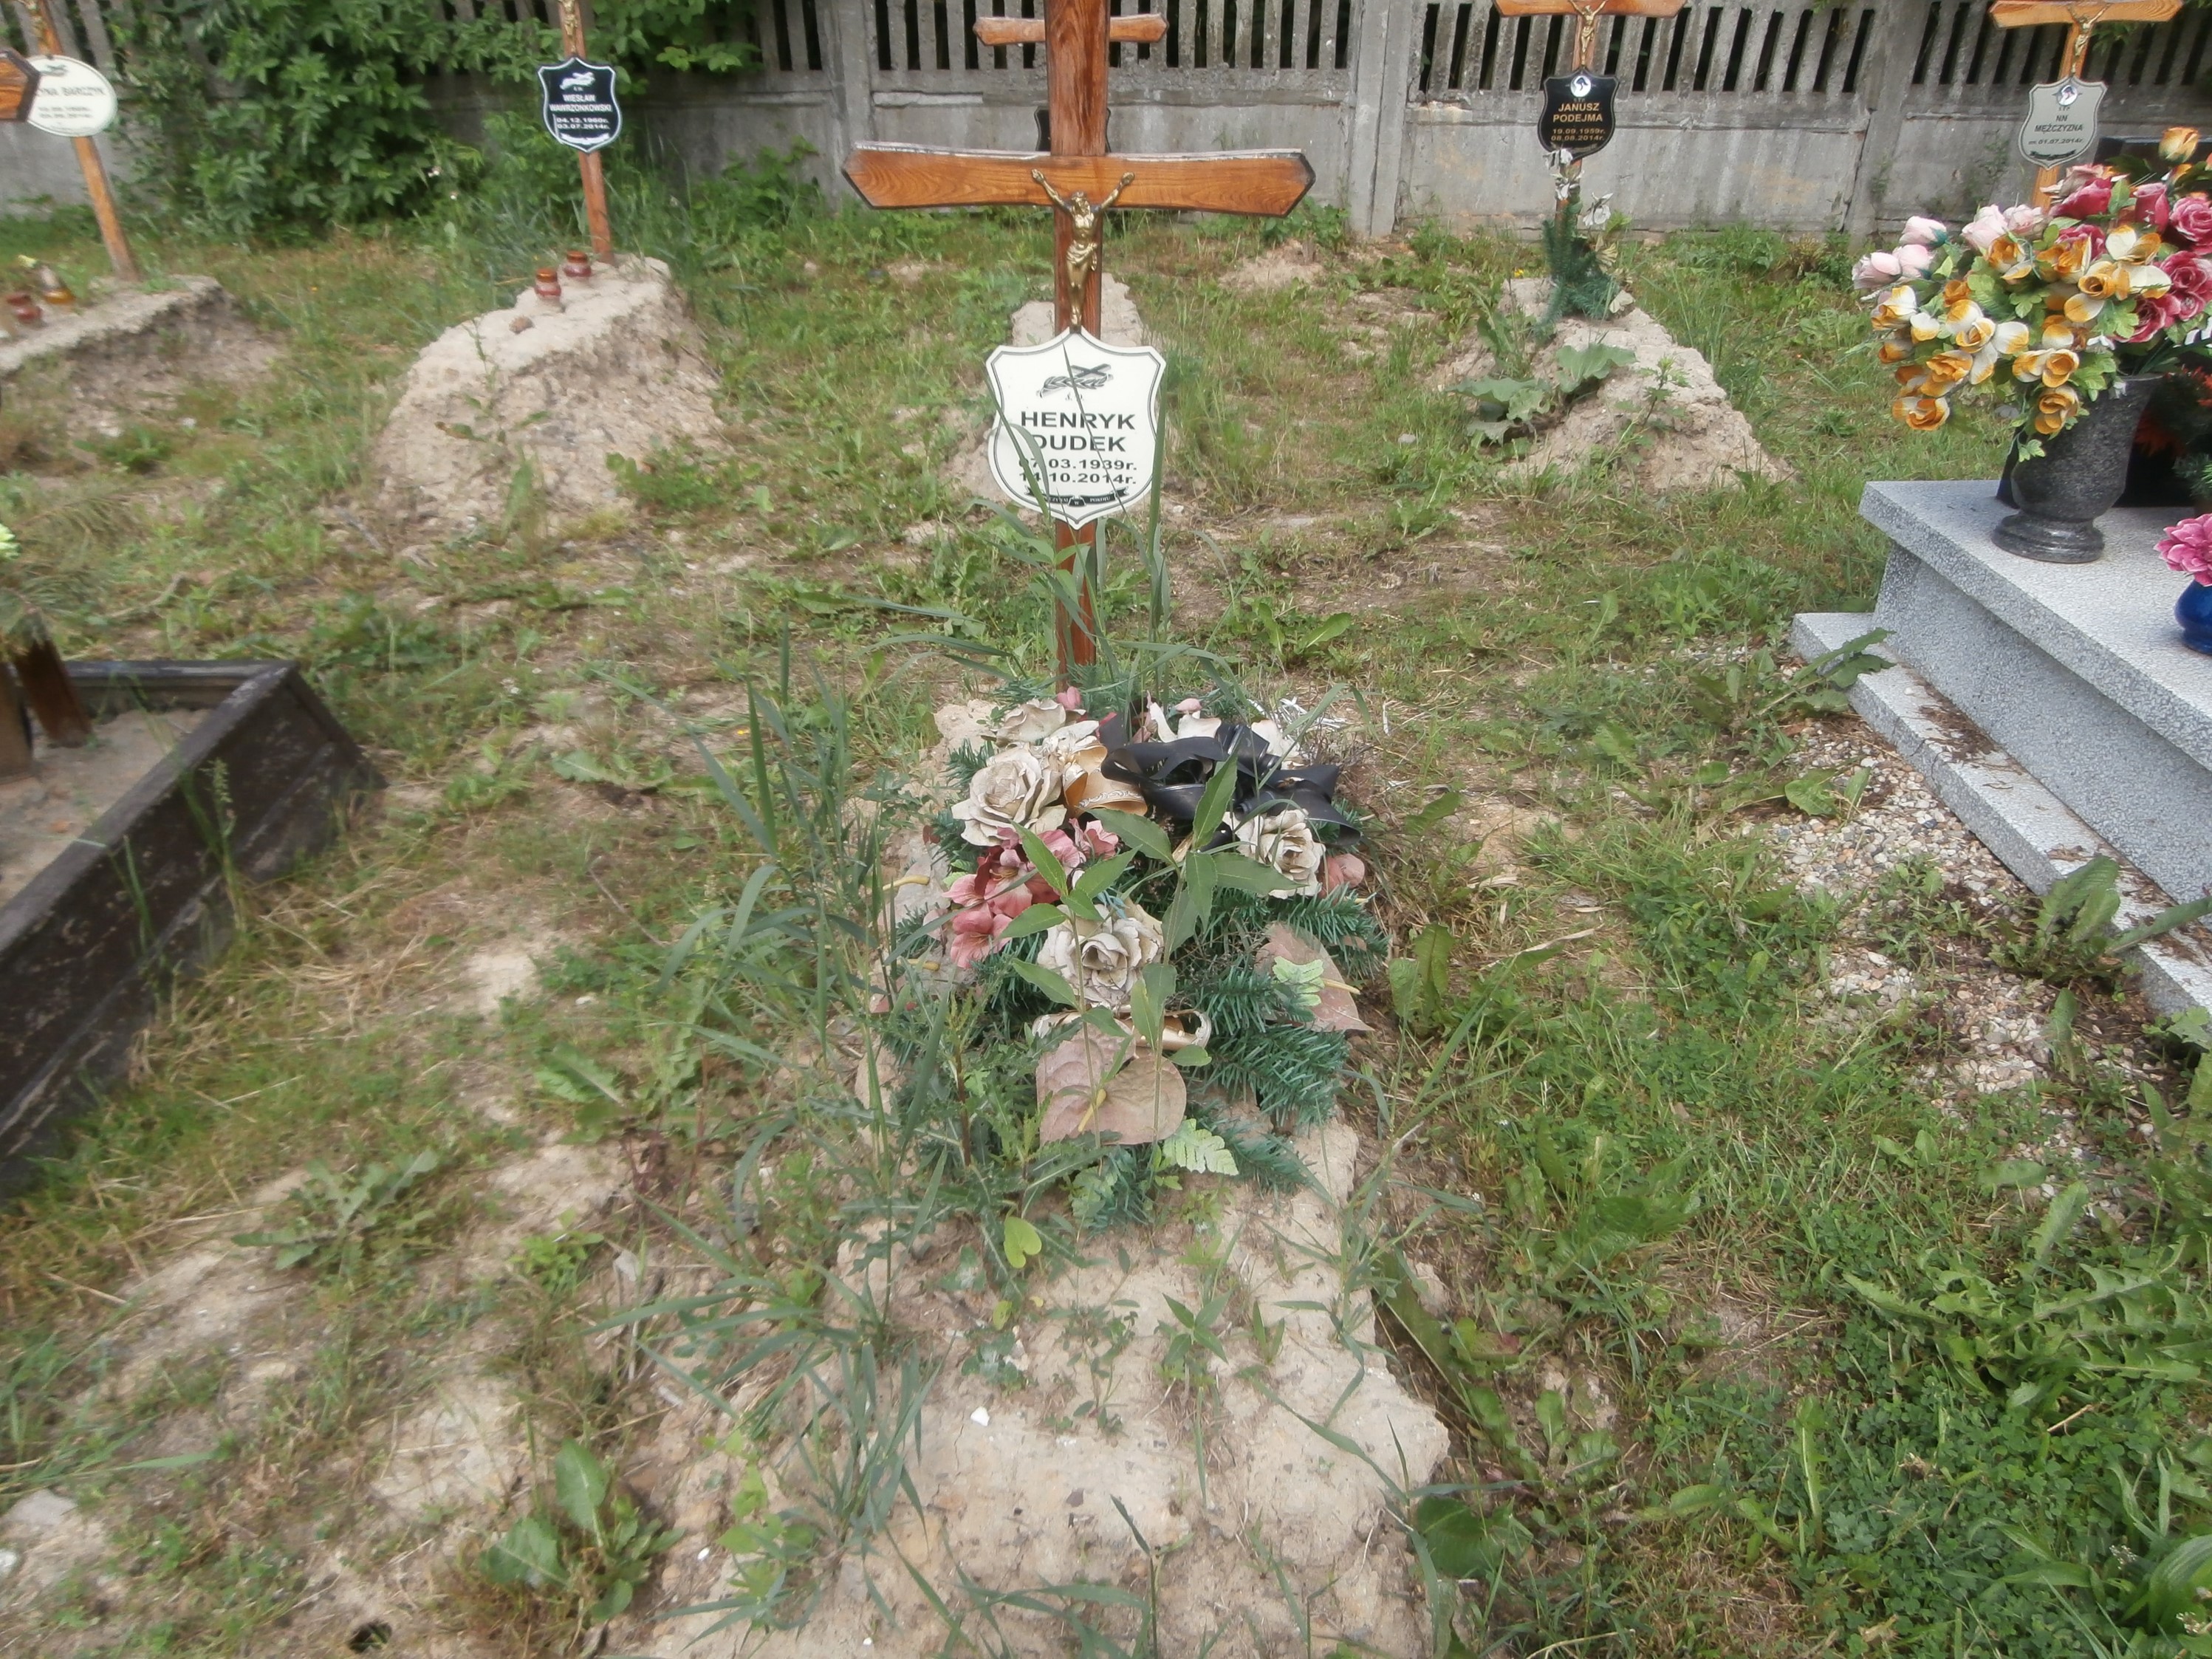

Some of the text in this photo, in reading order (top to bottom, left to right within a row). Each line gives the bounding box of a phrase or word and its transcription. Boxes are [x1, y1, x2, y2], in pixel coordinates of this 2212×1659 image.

[562, 94, 596, 102] WIESŁAW
[549, 104, 613, 112] WAWRZONKOWSKI
[1558, 103, 1600, 112] JANUSZ
[1552, 114, 1603, 123] PODEJMA
[1021, 411, 1136, 430] HENRYK
